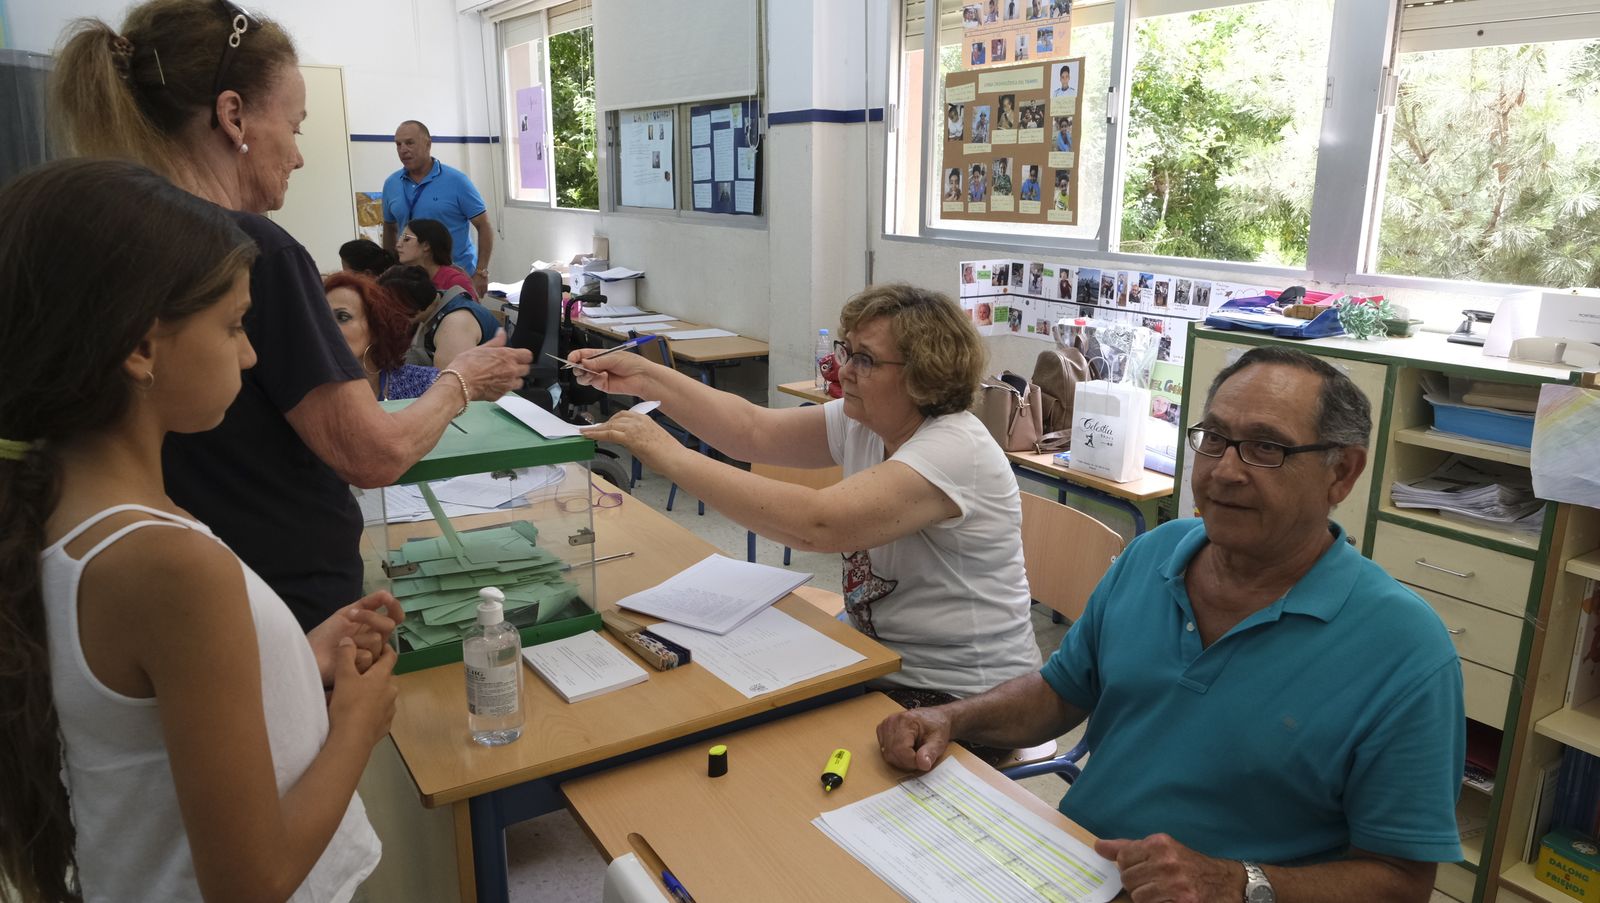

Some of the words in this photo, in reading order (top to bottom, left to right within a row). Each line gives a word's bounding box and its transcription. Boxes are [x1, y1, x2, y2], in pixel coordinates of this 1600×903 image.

[1080, 417, 1113, 435] Celestia
[1549, 858, 1589, 881] DALONG
[1547, 872, 1584, 895] FRIENDS
